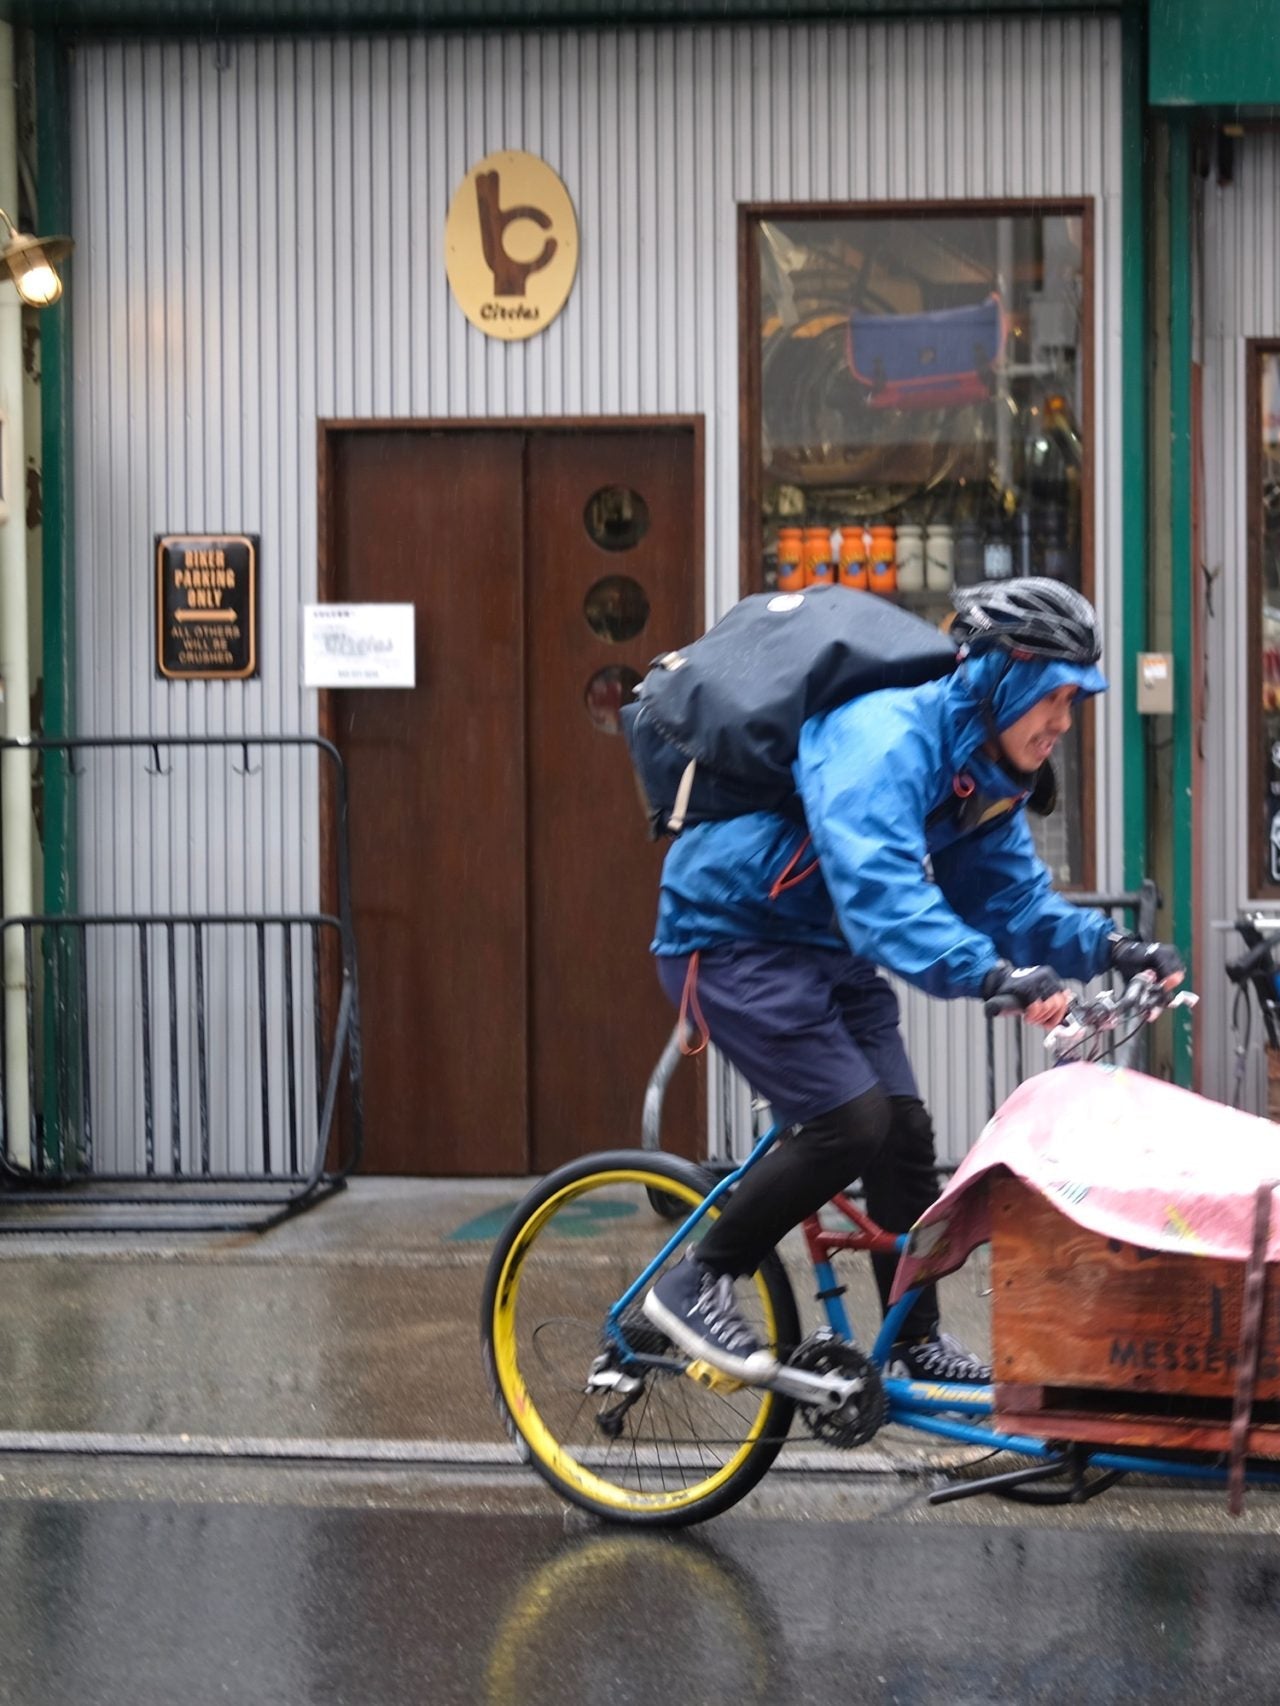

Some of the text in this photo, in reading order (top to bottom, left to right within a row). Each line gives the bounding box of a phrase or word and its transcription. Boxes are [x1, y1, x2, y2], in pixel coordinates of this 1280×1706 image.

[185, 549, 225, 569] BIKER
[175, 568, 236, 589] PARKING
[187, 588, 222, 608] ONLY
[171, 625, 240, 639] ALL OTHERS
[182, 638, 227, 652] WILL BE
[179, 650, 234, 665] CRUSHED
